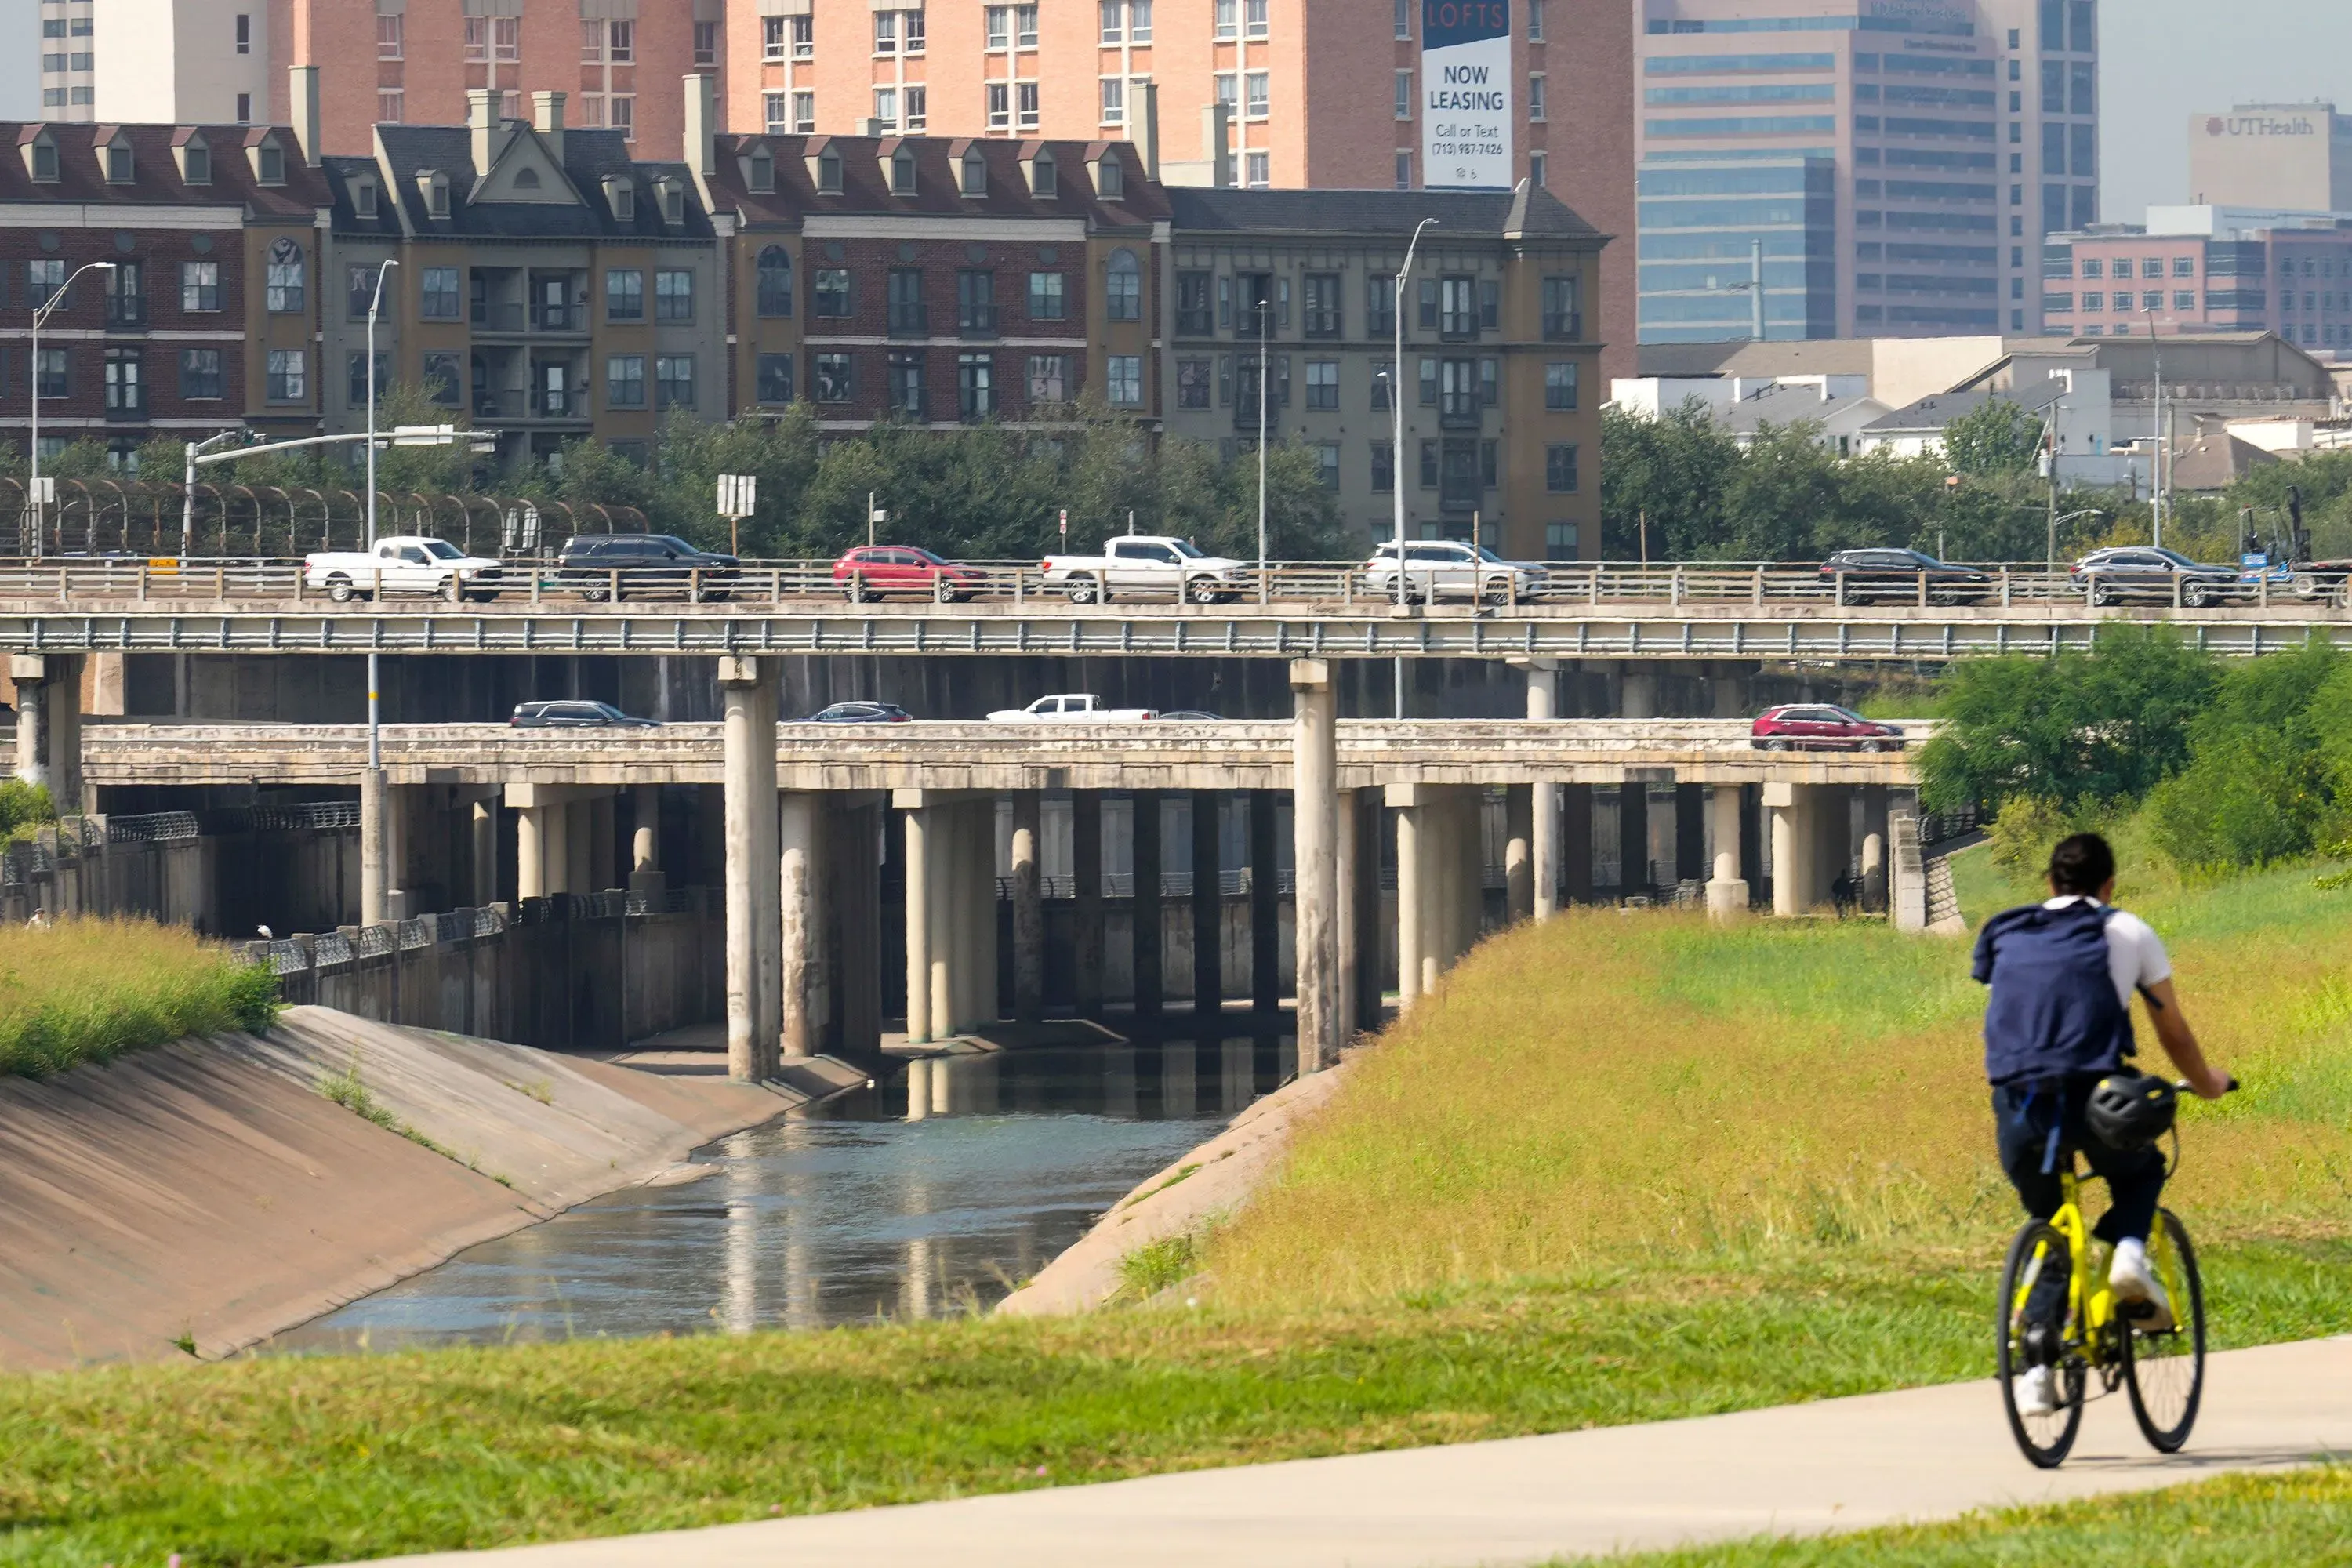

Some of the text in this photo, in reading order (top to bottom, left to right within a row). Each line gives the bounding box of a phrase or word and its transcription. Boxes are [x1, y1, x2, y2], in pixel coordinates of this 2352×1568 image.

[1428, 3, 1504, 28] LOFTS
[1444, 66, 1489, 84] NOW
[1430, 91, 1504, 111] LEASING
[1436, 123, 1499, 138] Call or Text
[2227, 117, 2314, 136] UTHealth
[1432, 143, 1503, 156] (713) 987-7426
